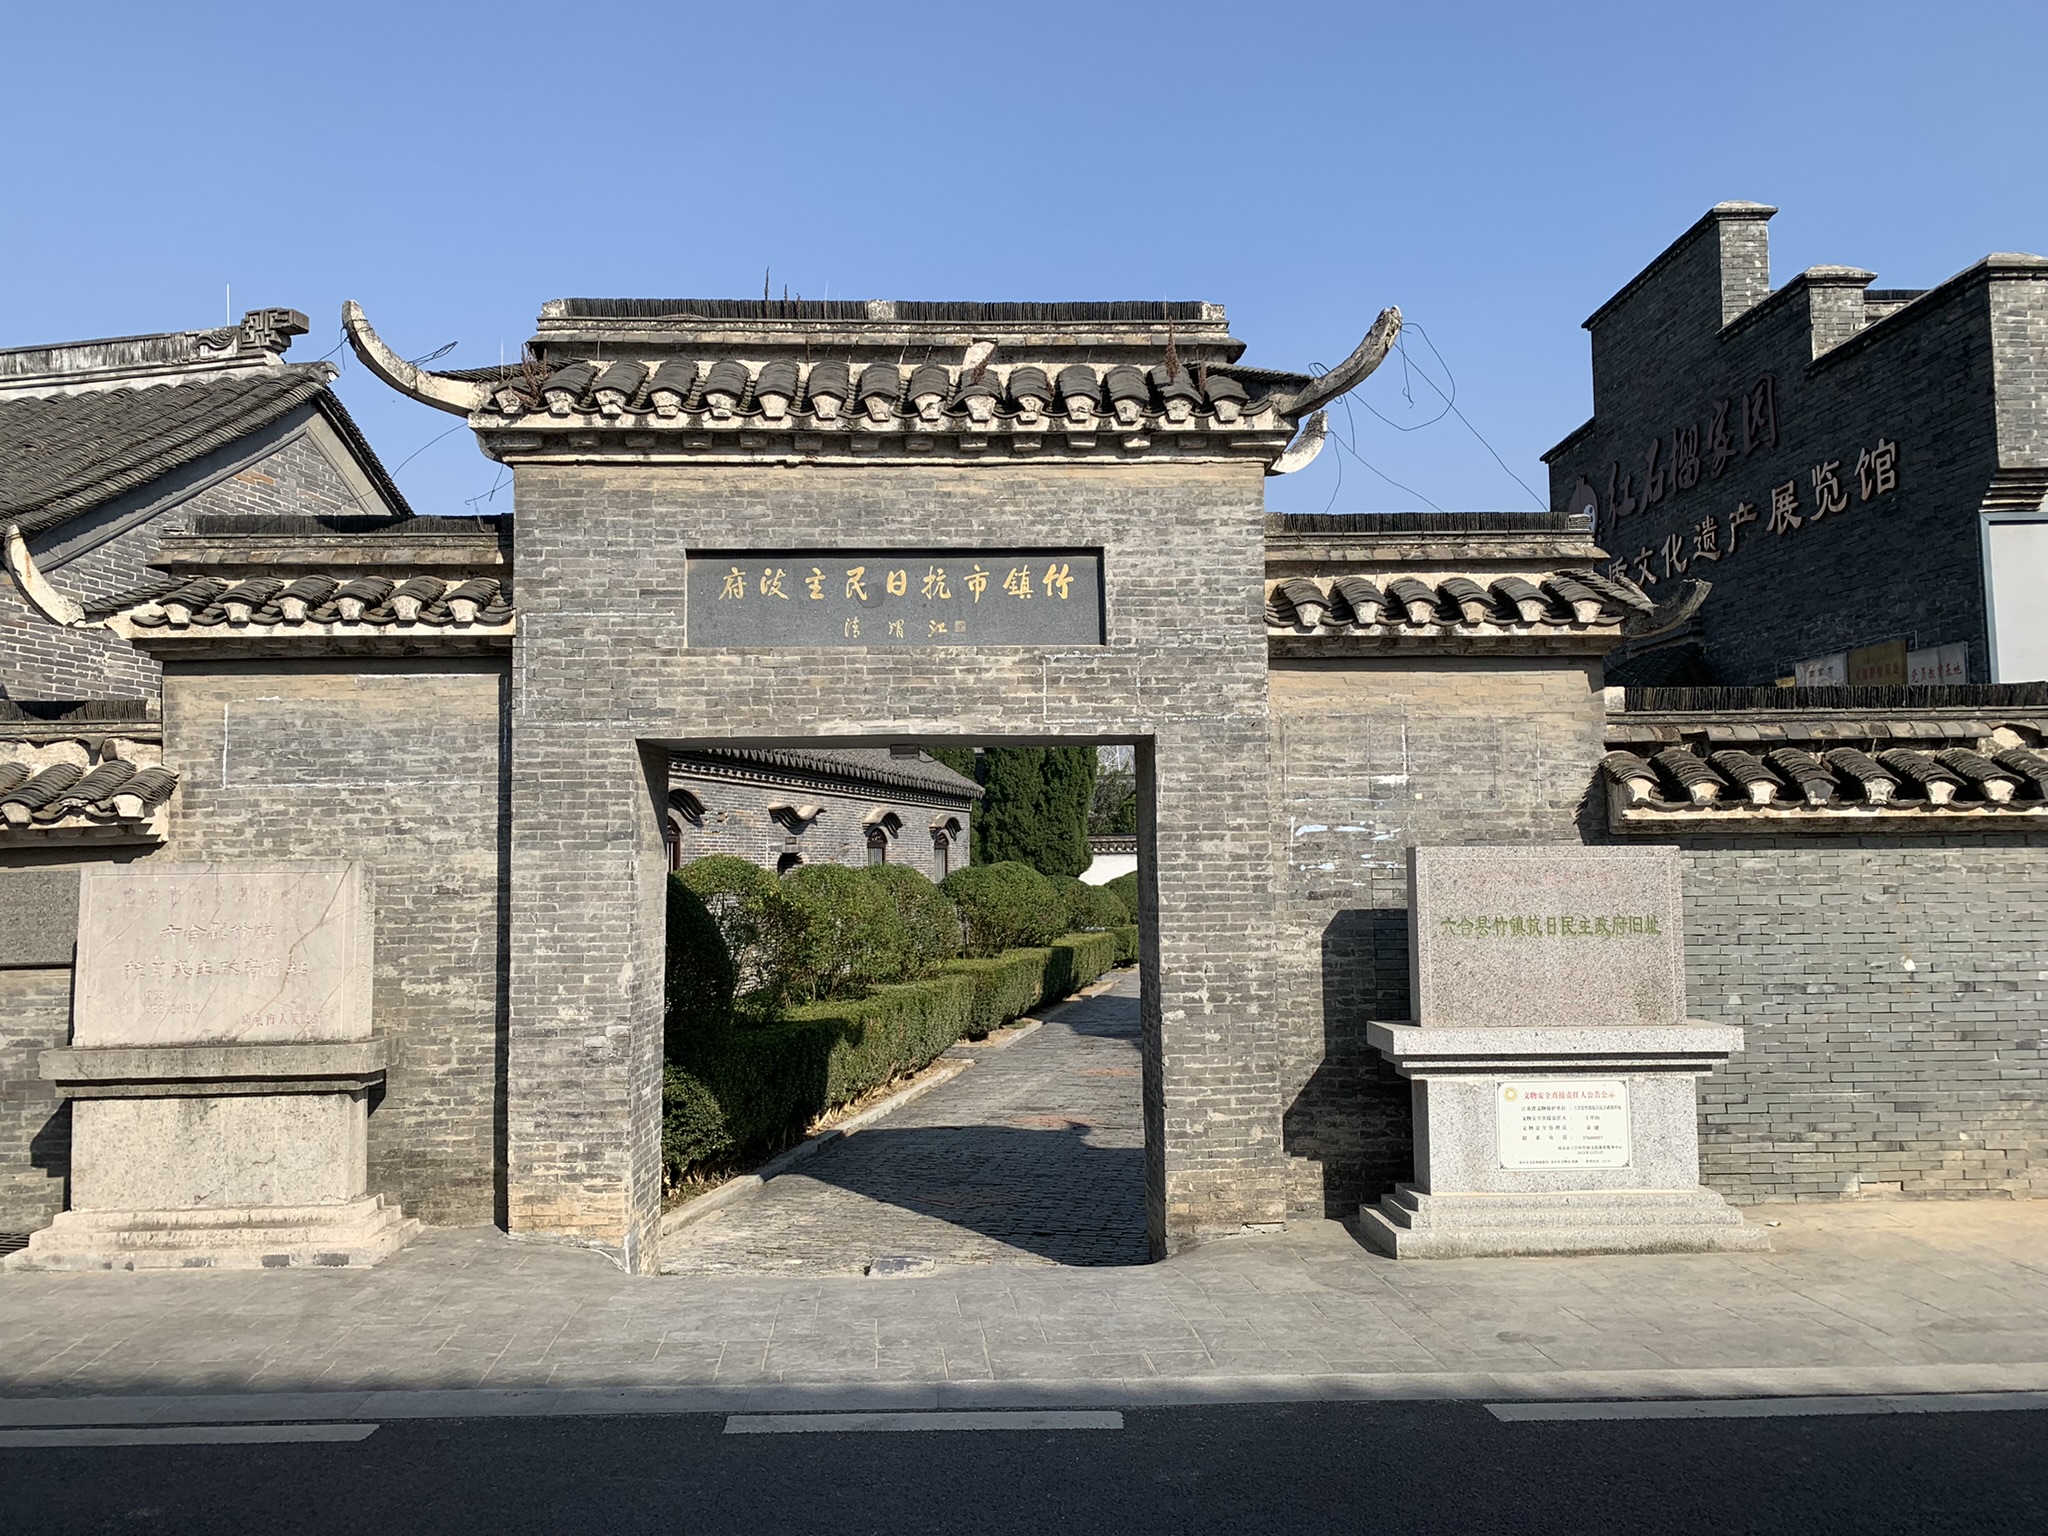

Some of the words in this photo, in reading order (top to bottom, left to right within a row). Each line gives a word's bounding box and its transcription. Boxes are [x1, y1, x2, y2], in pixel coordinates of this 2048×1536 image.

[1440, 914, 1663, 939] 六合县竹镇抗日民主政府旧址
